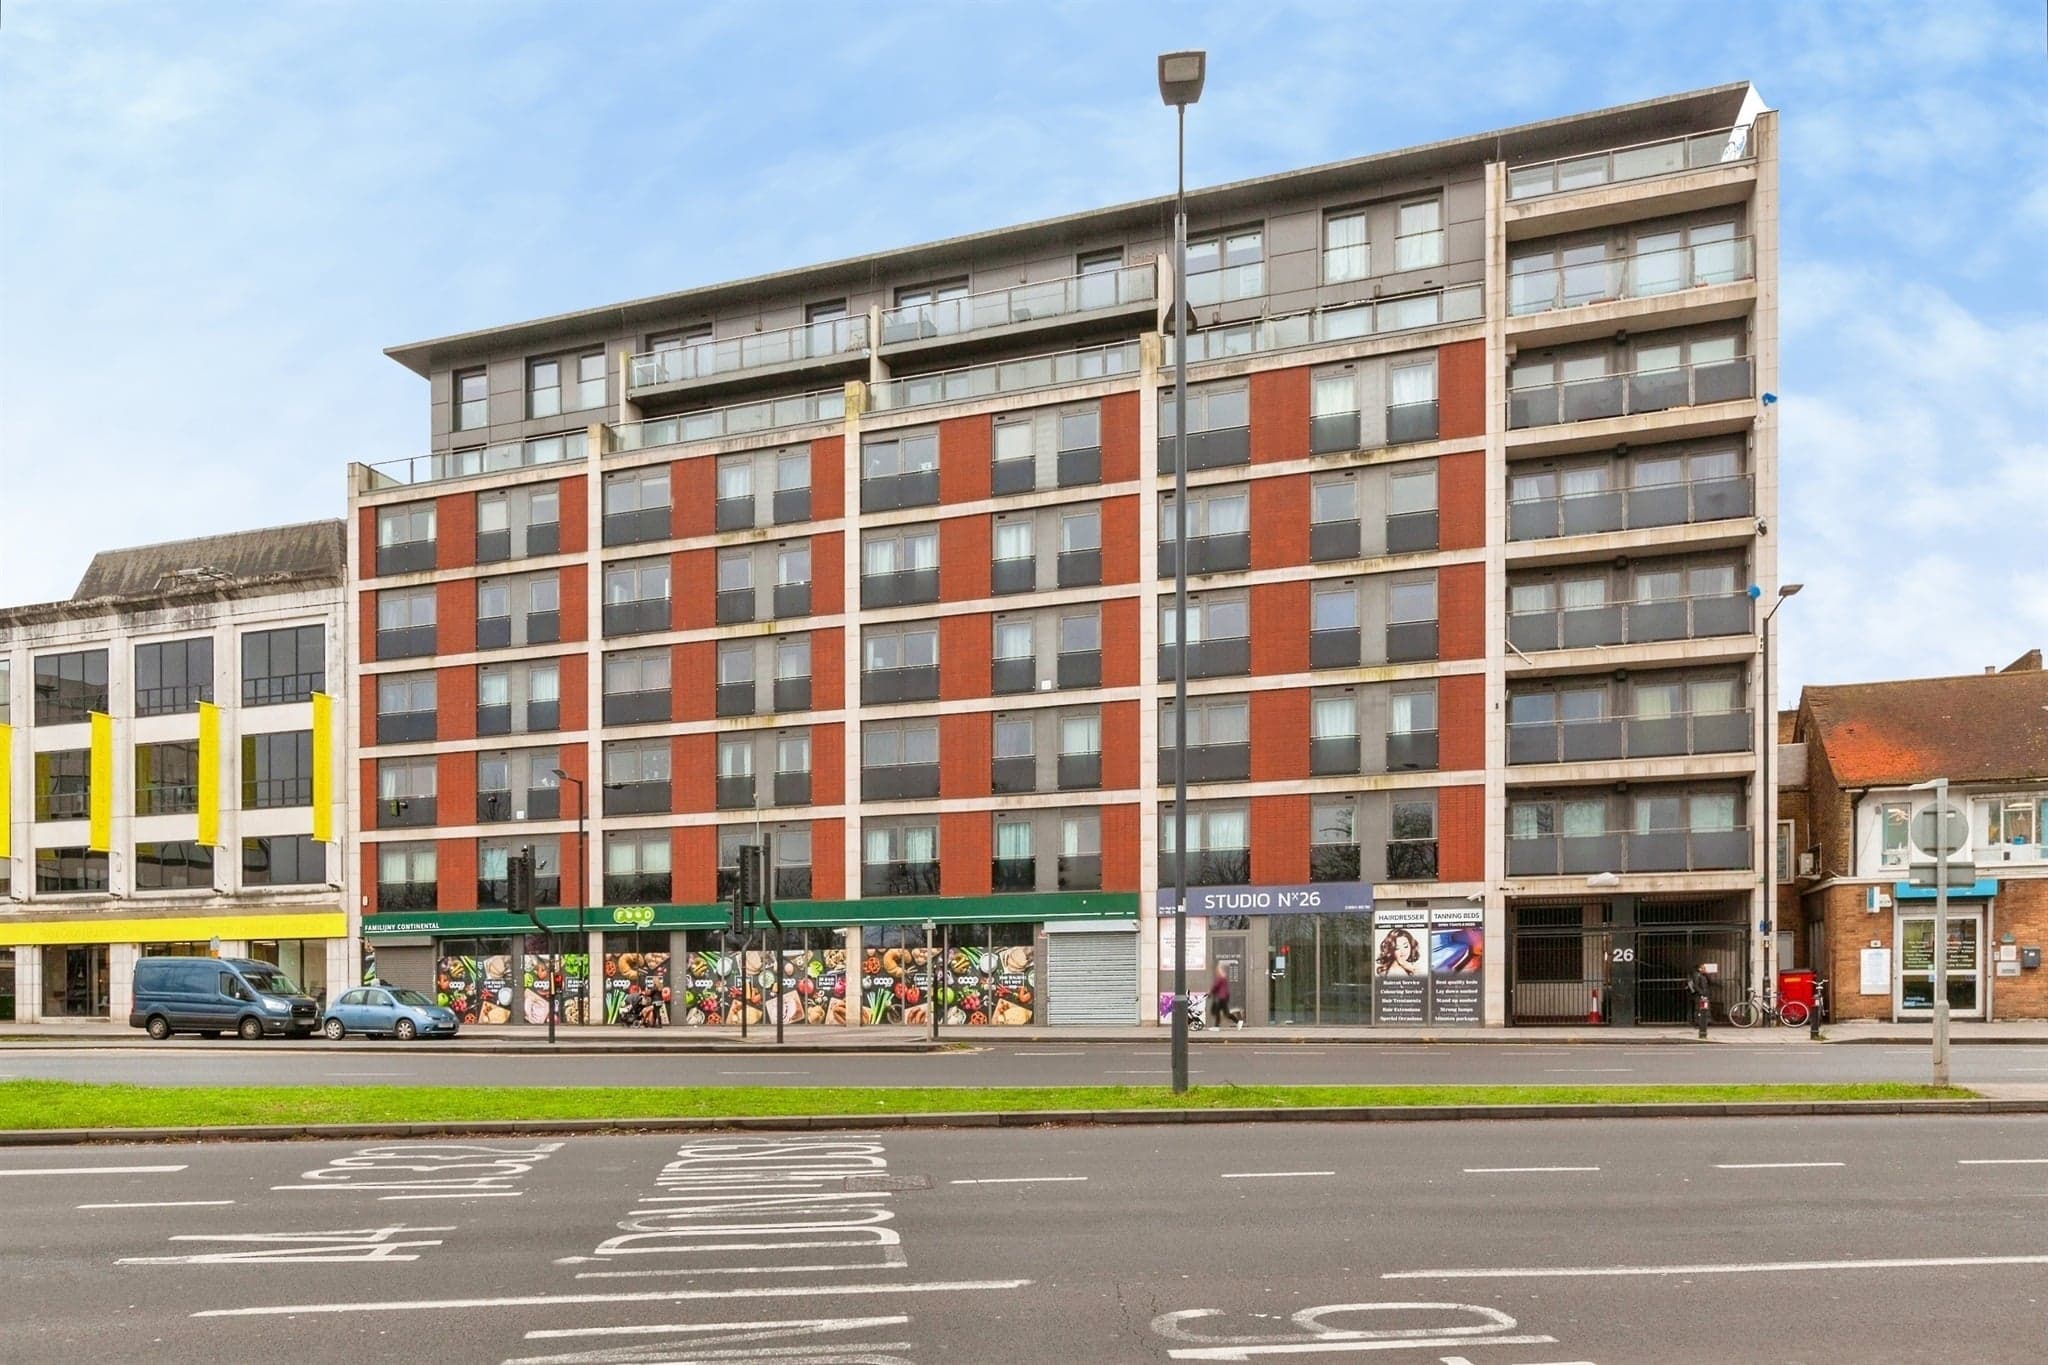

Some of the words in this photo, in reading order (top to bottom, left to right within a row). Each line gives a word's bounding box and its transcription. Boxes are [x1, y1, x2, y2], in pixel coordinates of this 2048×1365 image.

[1204, 893, 1270, 909] STUDIO
[1434, 912, 1462, 920] TANNING
[397, 922, 440, 930] CONTINENTAL
[1612, 948, 1634, 962] 26
[269, 1143, 566, 1190] A332
[113, 1223, 457, 1265] A4
